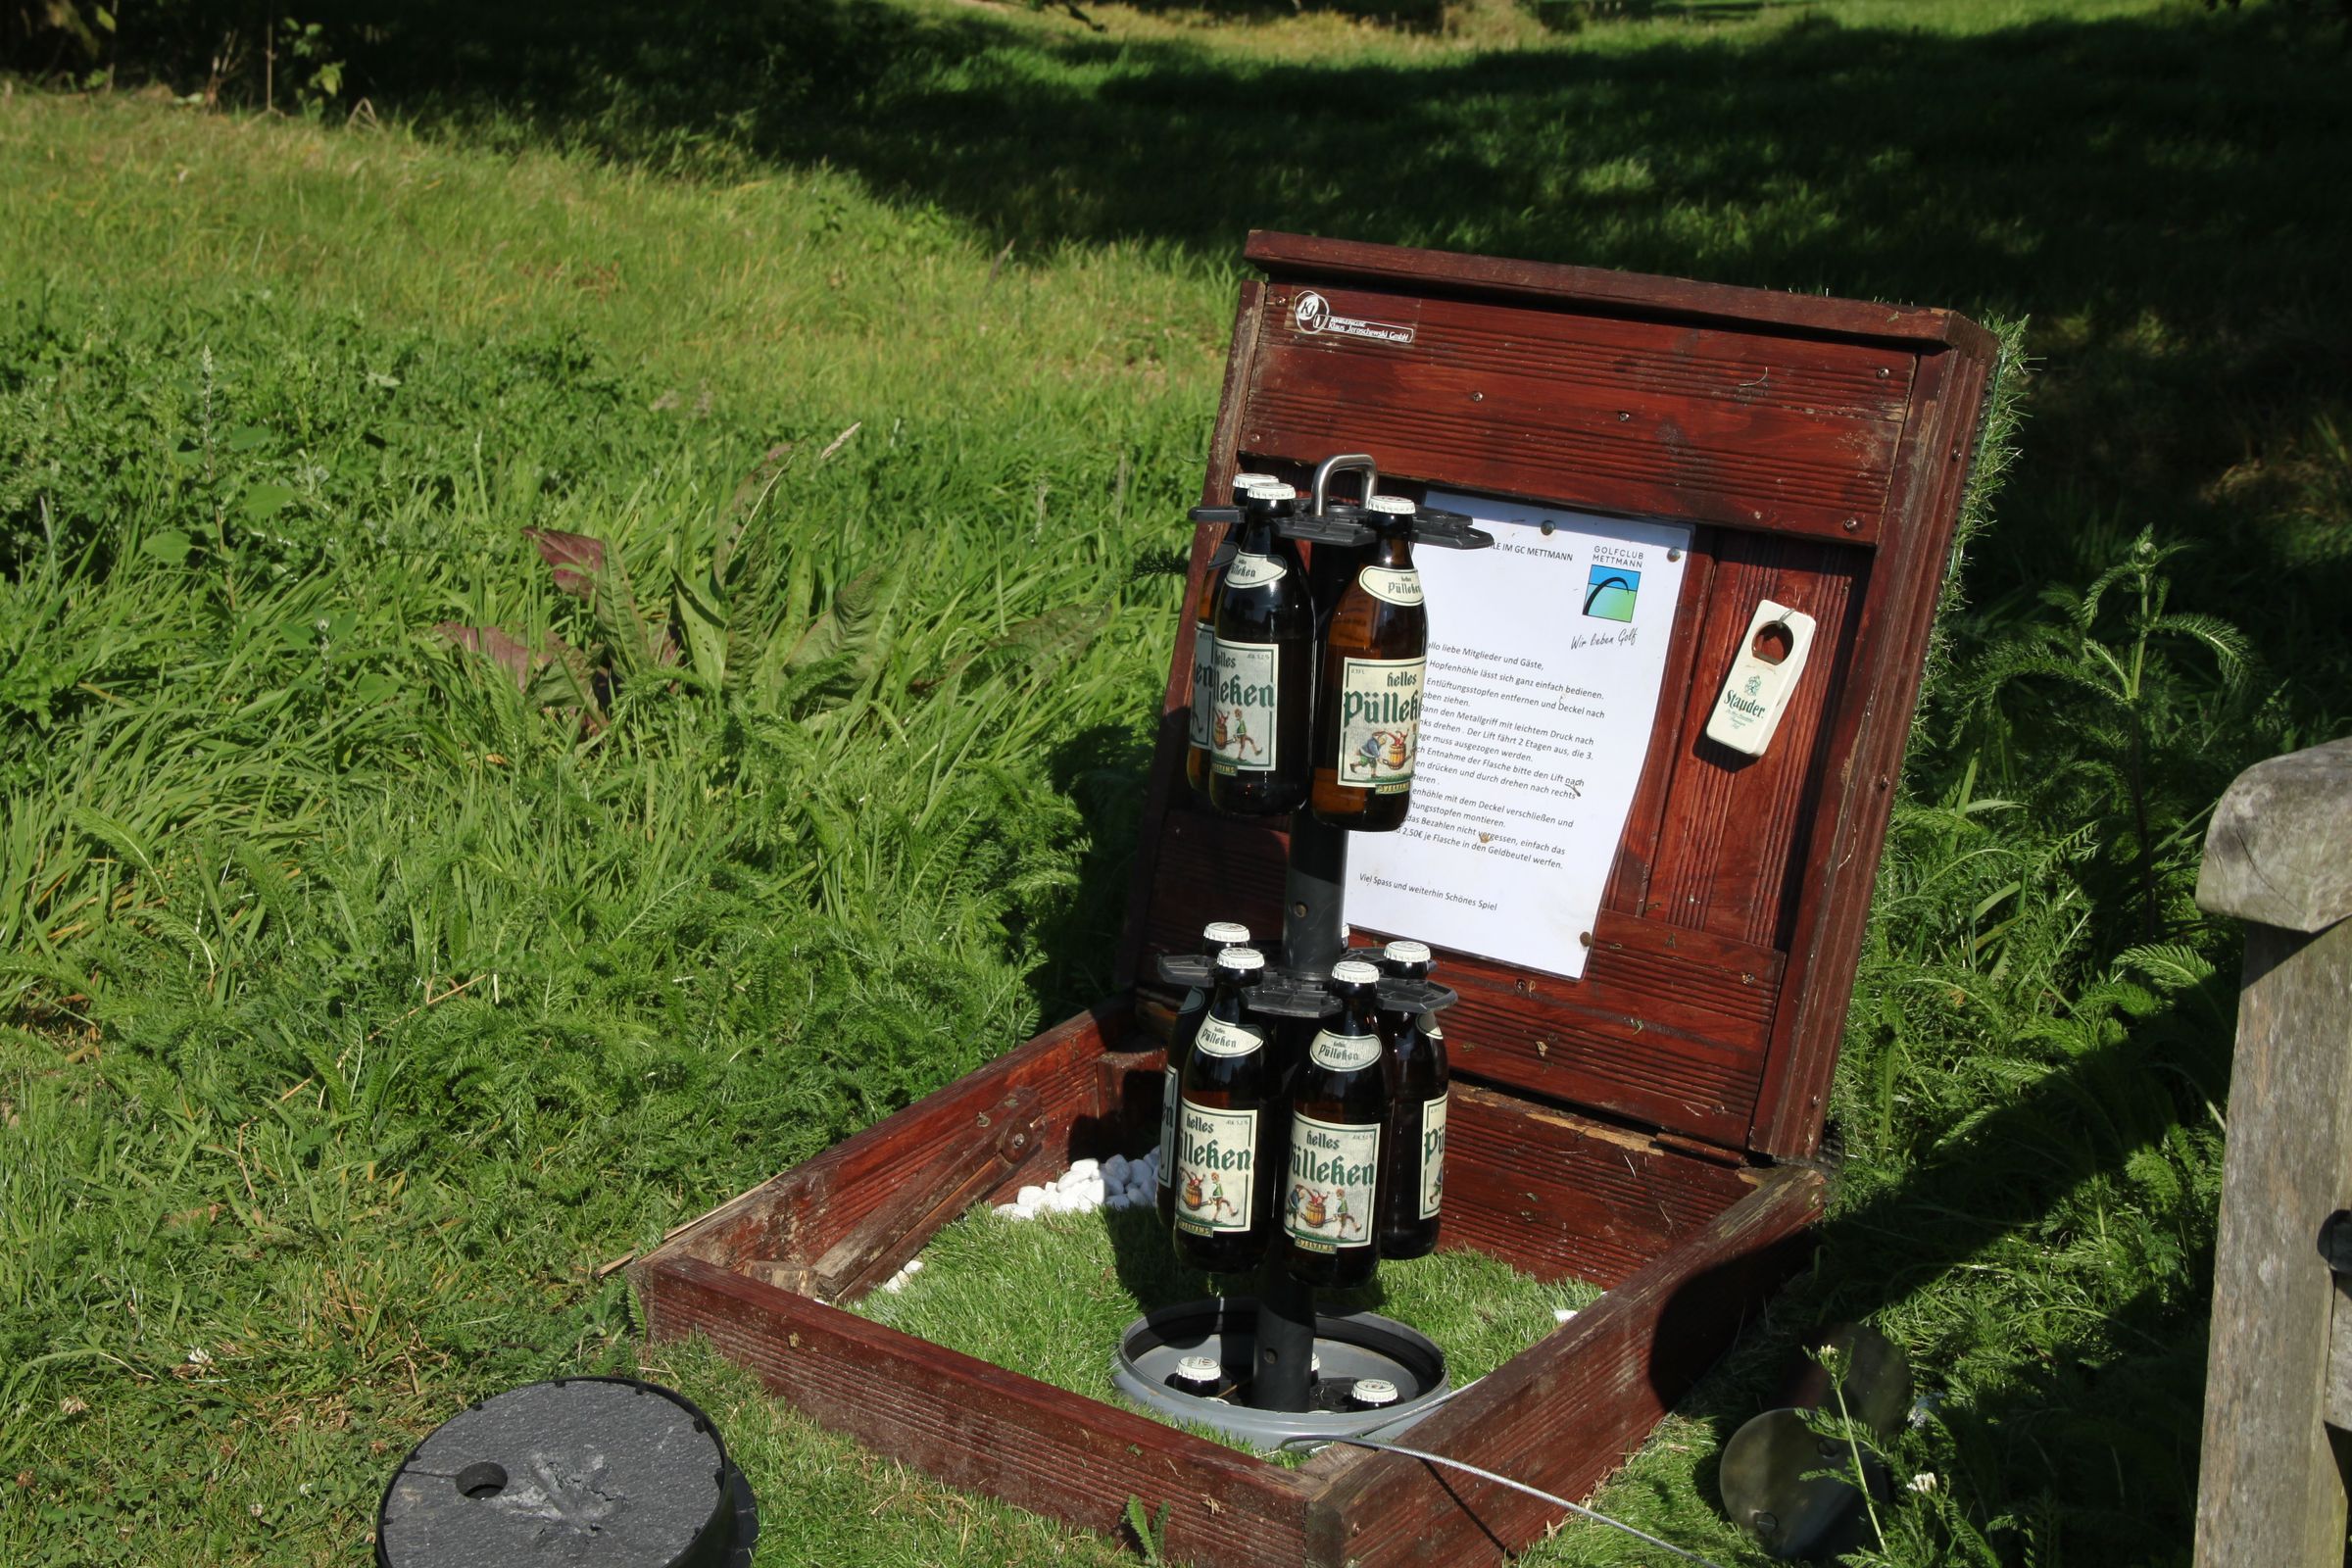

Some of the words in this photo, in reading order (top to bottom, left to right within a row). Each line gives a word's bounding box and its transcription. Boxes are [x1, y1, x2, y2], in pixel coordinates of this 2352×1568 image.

[1390, 331, 1408, 341] GmbH
[1502, 543, 1513, 552] IM
[1514, 545, 1525, 554] GC
[1527, 547, 1573, 562] METTMANN
[1592, 554, 1642, 568] METTMANN
[1593, 545, 1643, 560] GOLFCLUB
[1571, 635, 1587, 650] Wir
[1618, 627, 1638, 646] Golf
[1442, 644, 1461, 655] liebe
[1462, 648, 1502, 662] Mitglieder
[1520, 659, 1544, 671] Gäste,
[1388, 671, 1417, 687] helles
[1429, 660, 1479, 676] Hopfenhöhle
[1480, 669, 1497, 680] lässt
[1515, 677, 1534, 686] ganz
[1536, 680, 1564, 692] einfach
[1565, 686, 1603, 700] bedienen.
[1423, 690, 1442, 701] oben
[1443, 696, 1470, 707] ziehen.
[1427, 677, 1499, 698] Entlüftungsstopfen
[1500, 694, 1539, 706] entfernen
[1558, 702, 1585, 714] Deckel
[1586, 710, 1604, 718] nach
[1724, 690, 1765, 717] Stauder
[1440, 708, 1454, 717] den
[1456, 711, 1498, 726] Metallgriff
[1514, 722, 1548, 736] leichtem
[1549, 730, 1574, 742] Druck
[1433, 721, 1460, 733] drehen
[1467, 727, 1482, 737] Der
[1483, 731, 1495, 740] Lift
[1497, 733, 1517, 745] fährt
[1525, 739, 1552, 752] Etagen
[1553, 747, 1569, 757] aus,
[1572, 749, 1584, 759] die
[1433, 736, 1453, 745] muss
[1454, 741, 1499, 755] ausgezogen
[1501, 750, 1533, 762] werden.
[1427, 747, 1466, 762] Entnahme
[1467, 755, 1482, 764] der
[1482, 759, 1511, 771] Flasche
[1512, 764, 1532, 776] bitte
[1533, 770, 1548, 779] den
[1550, 773, 1564, 783] Lift
[1427, 761, 1457, 774] drücken
[1476, 772, 1499, 783] durch
[1500, 777, 1529, 790] drehen
[1530, 785, 1549, 794] nach
[1551, 789, 1576, 800] rechts
[1445, 795, 1458, 804] mit
[1459, 797, 1477, 807] dem
[1478, 801, 1505, 812] Deckel
[1506, 808, 1556, 823] verschließen
[1463, 813, 1505, 827] montieren.
[1402, 827, 1423, 838] 2,50€
[1423, 832, 1432, 841] je
[1433, 833, 1460, 847] Flasche
[1462, 840, 1470, 849] in
[1471, 841, 1486, 852] den
[1488, 846, 1532, 861] Geldbeutel
[1533, 857, 1562, 869] werfen.
[1407, 814, 1420, 823] das
[1421, 817, 1455, 831] Bezahlen
[1456, 825, 1476, 836] nicht
[1520, 839, 1549, 852] einfach
[1550, 846, 1566, 855] das
[1360, 873, 1372, 883] Viel
[1373, 876, 1392, 887] Spass
[1409, 886, 1444, 899] weiterhin
[1445, 892, 1476, 906] Schönes
[1478, 900, 1497, 910] Spiel
[1186, 1113, 1214, 1133] helles
[1306, 1130, 1340, 1150] helles
